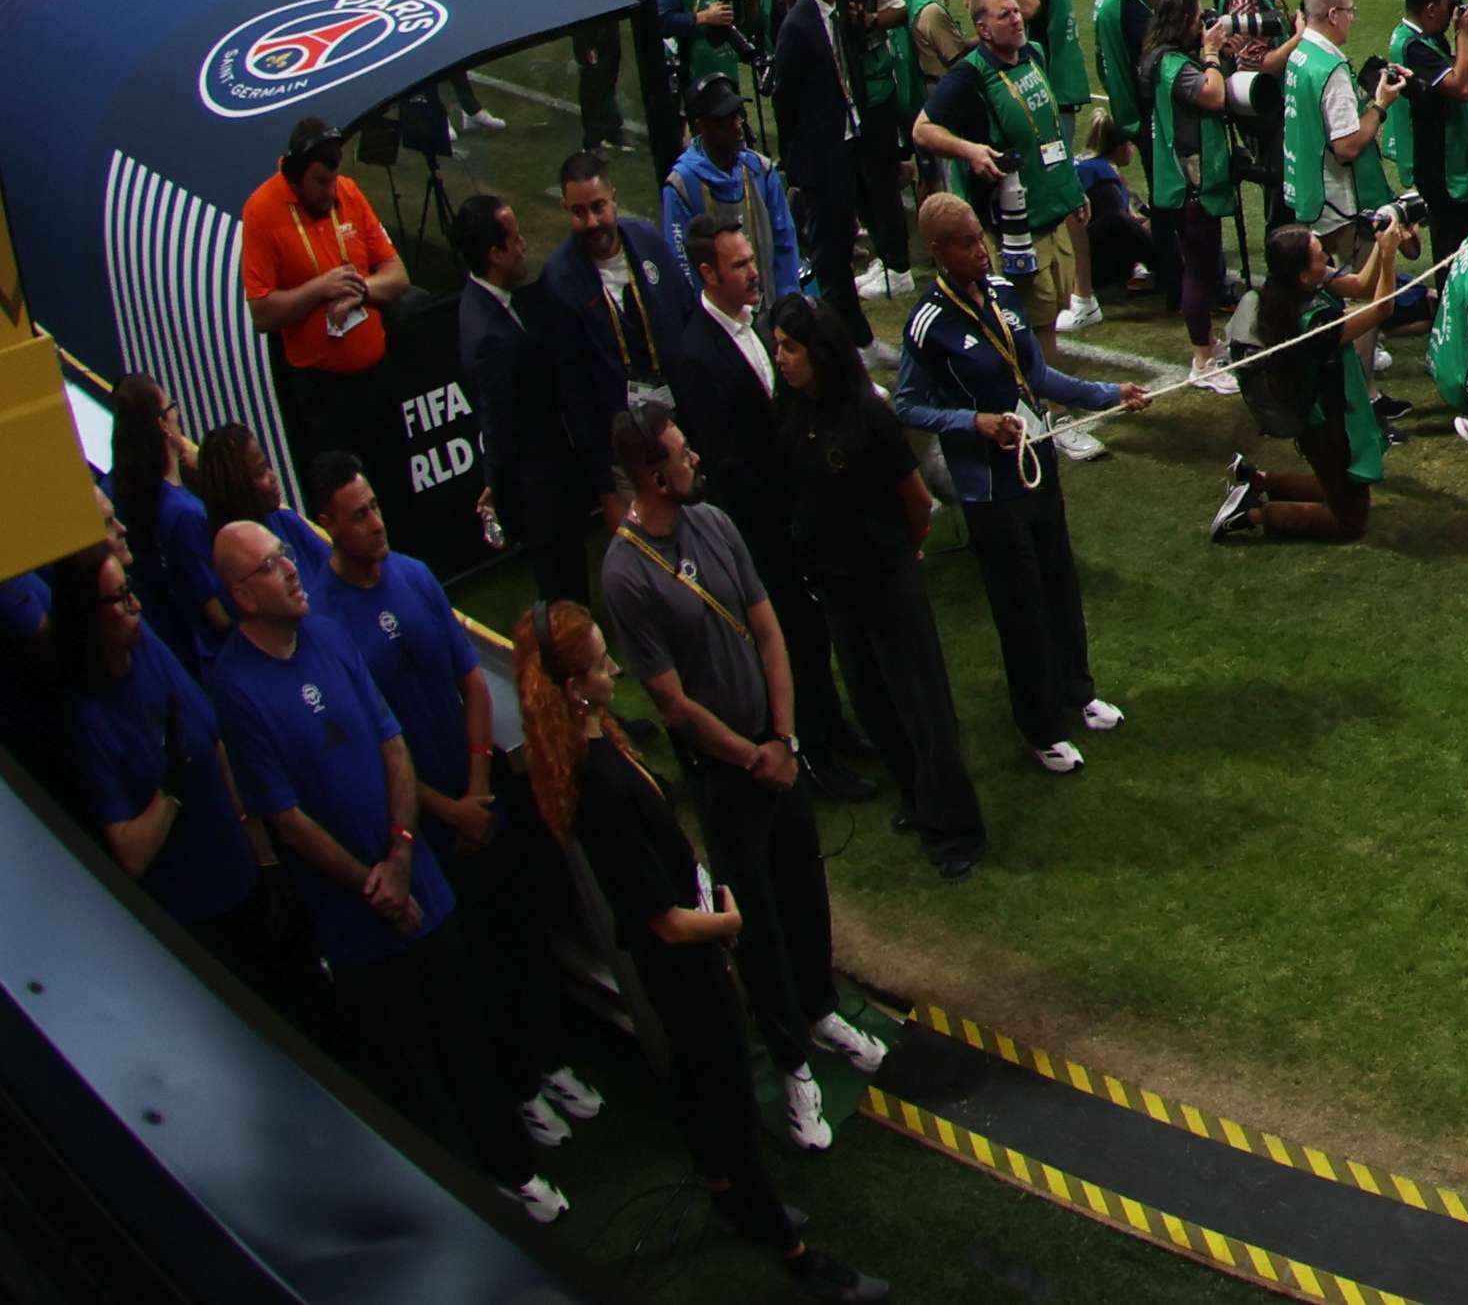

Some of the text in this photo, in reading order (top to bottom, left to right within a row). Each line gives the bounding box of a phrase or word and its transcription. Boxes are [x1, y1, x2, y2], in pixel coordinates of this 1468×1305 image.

[1013, 70, 1045, 95] HOTO
[1027, 89, 1050, 111] 629
[402, 381, 473, 439] FIFA
[410, 437, 475, 493] RLD
